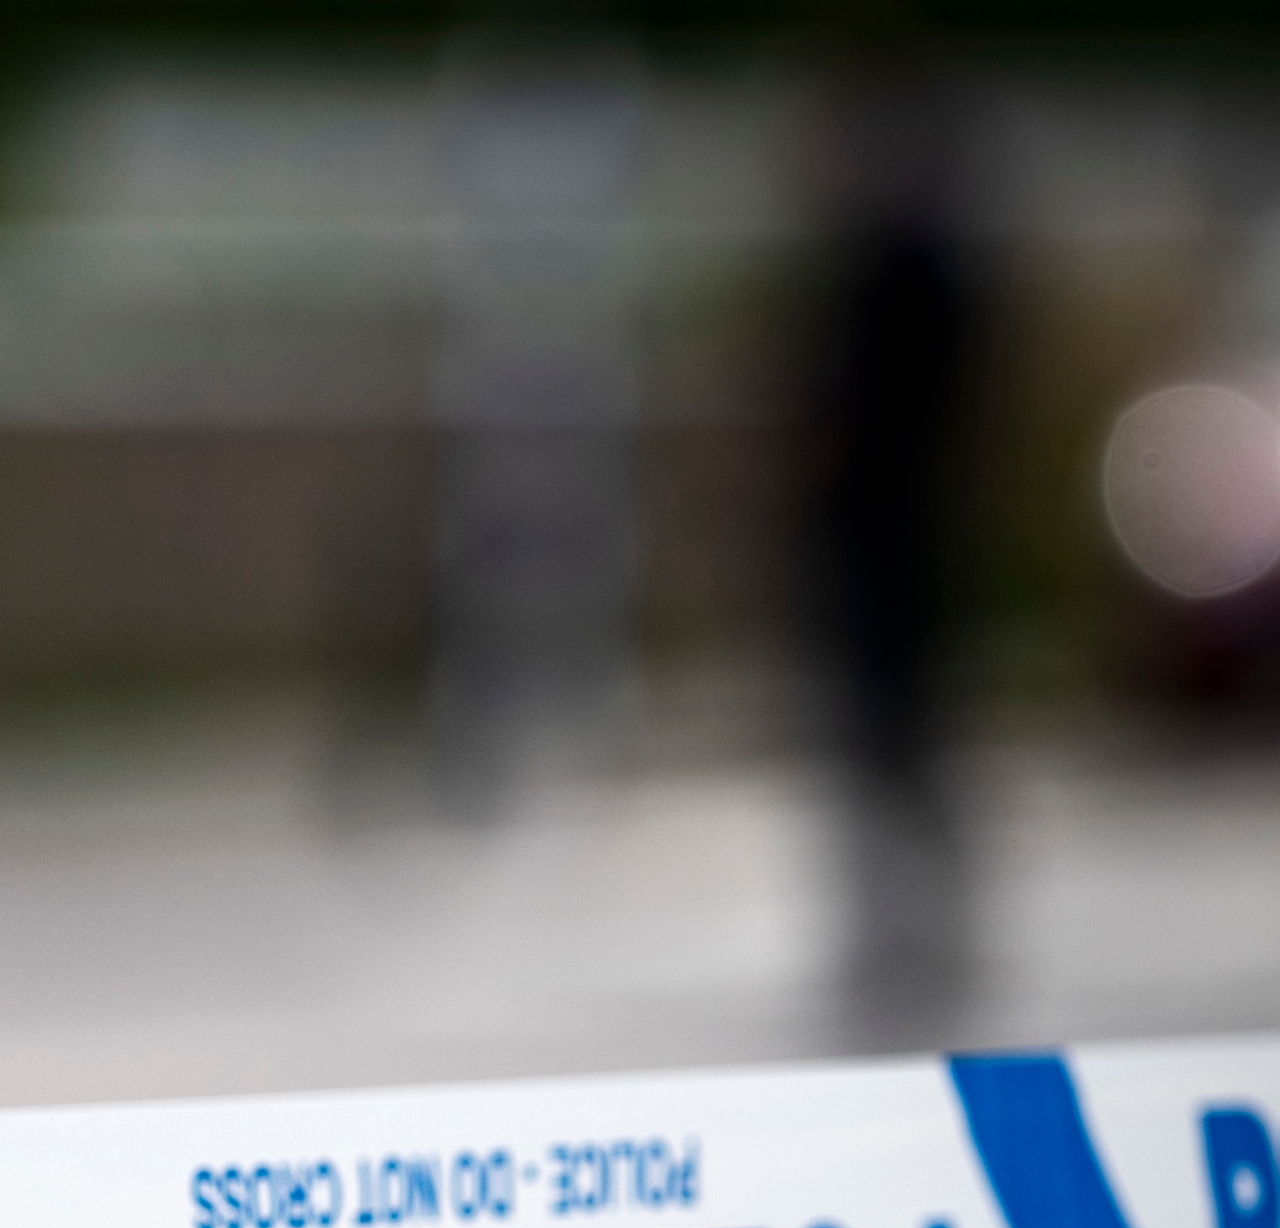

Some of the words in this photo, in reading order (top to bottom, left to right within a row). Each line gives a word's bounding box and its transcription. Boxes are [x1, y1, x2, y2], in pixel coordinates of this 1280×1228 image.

[354, 1154, 440, 1227] NOT
[455, 1149, 514, 1219] DO
[550, 1138, 700, 1214] POLICE
